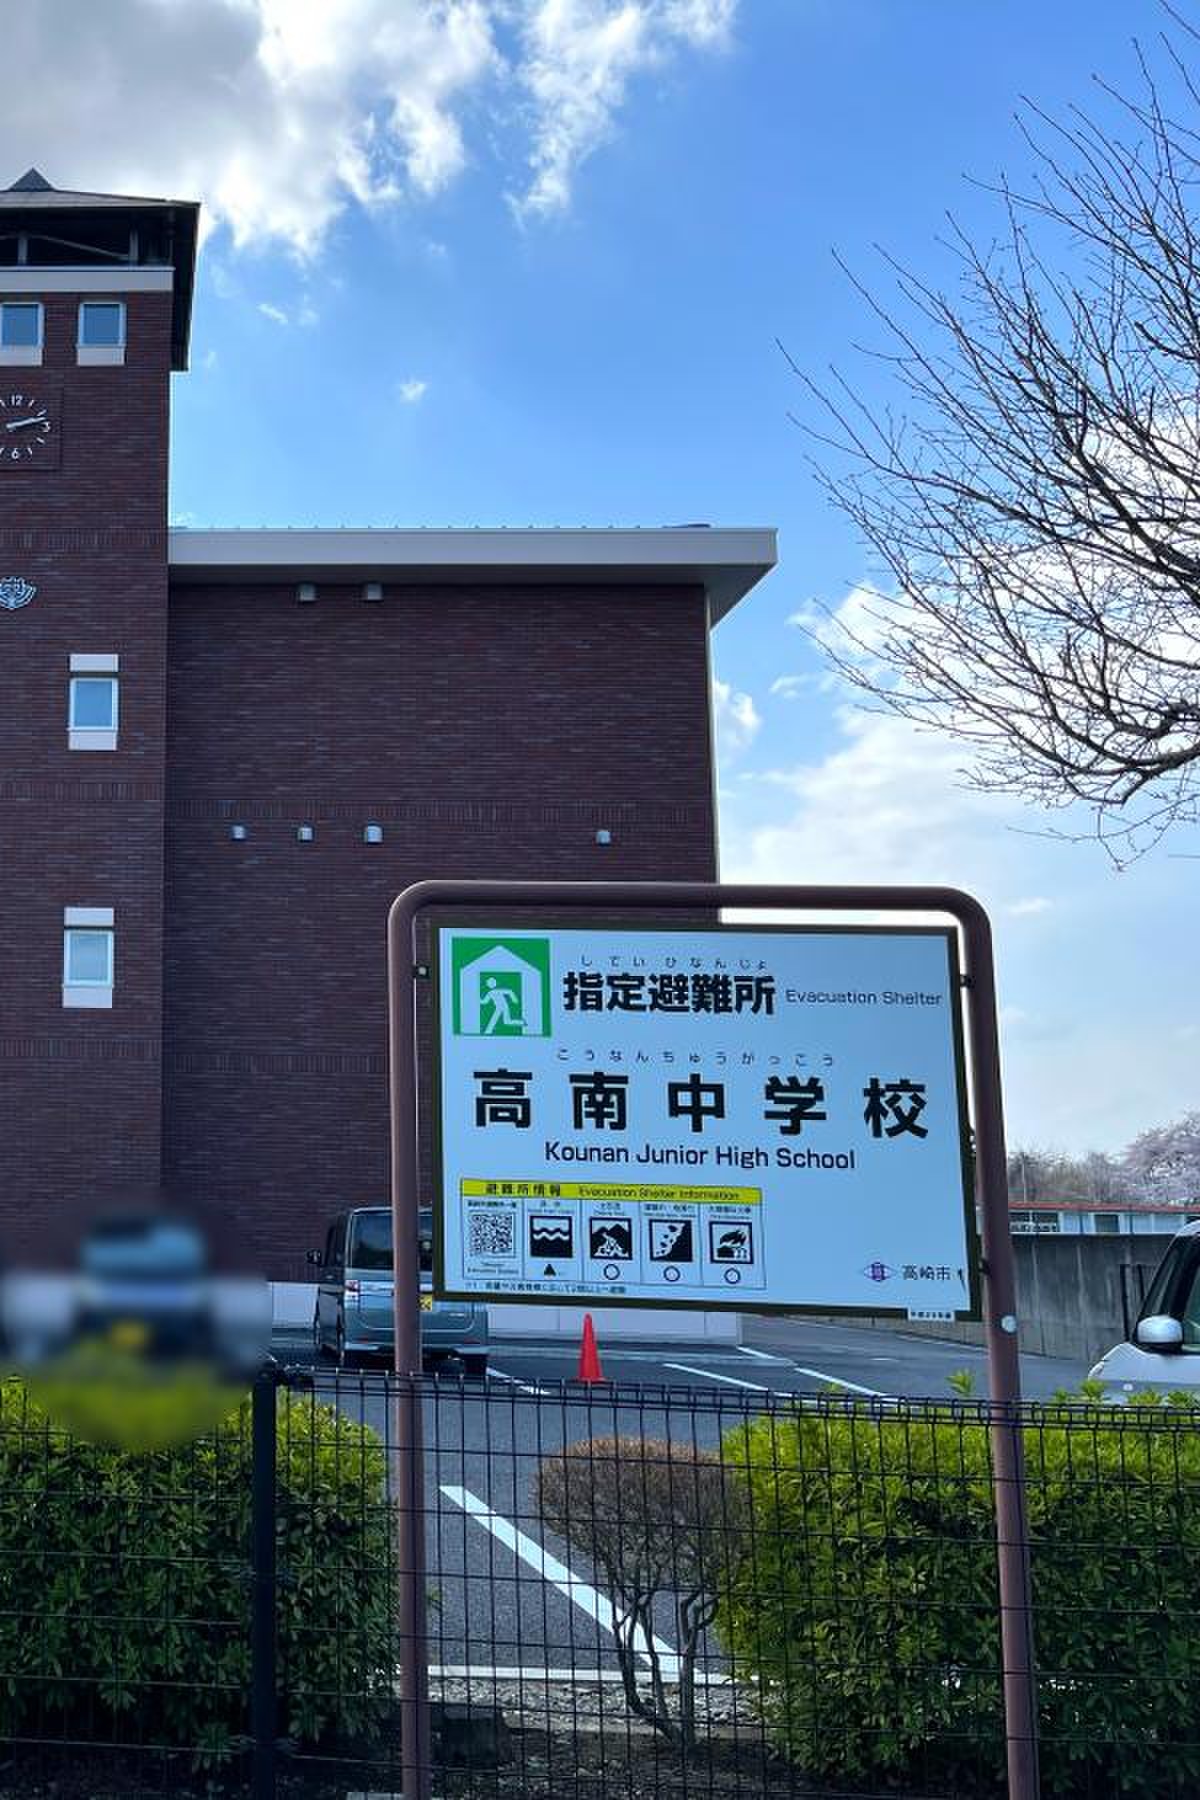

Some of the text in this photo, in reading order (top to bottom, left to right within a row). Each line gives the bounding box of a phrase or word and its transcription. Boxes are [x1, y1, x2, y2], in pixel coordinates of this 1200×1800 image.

[11, 395, 23, 406] 12
[11, 447, 20, 459] 6
[563, 971, 776, 1014] 指定避難所
[785, 989, 943, 1006] Evacuation Shelter
[473, 1068, 929, 1138] 高南中学校
[545, 1141, 855, 1169] Kounan Junior High School
